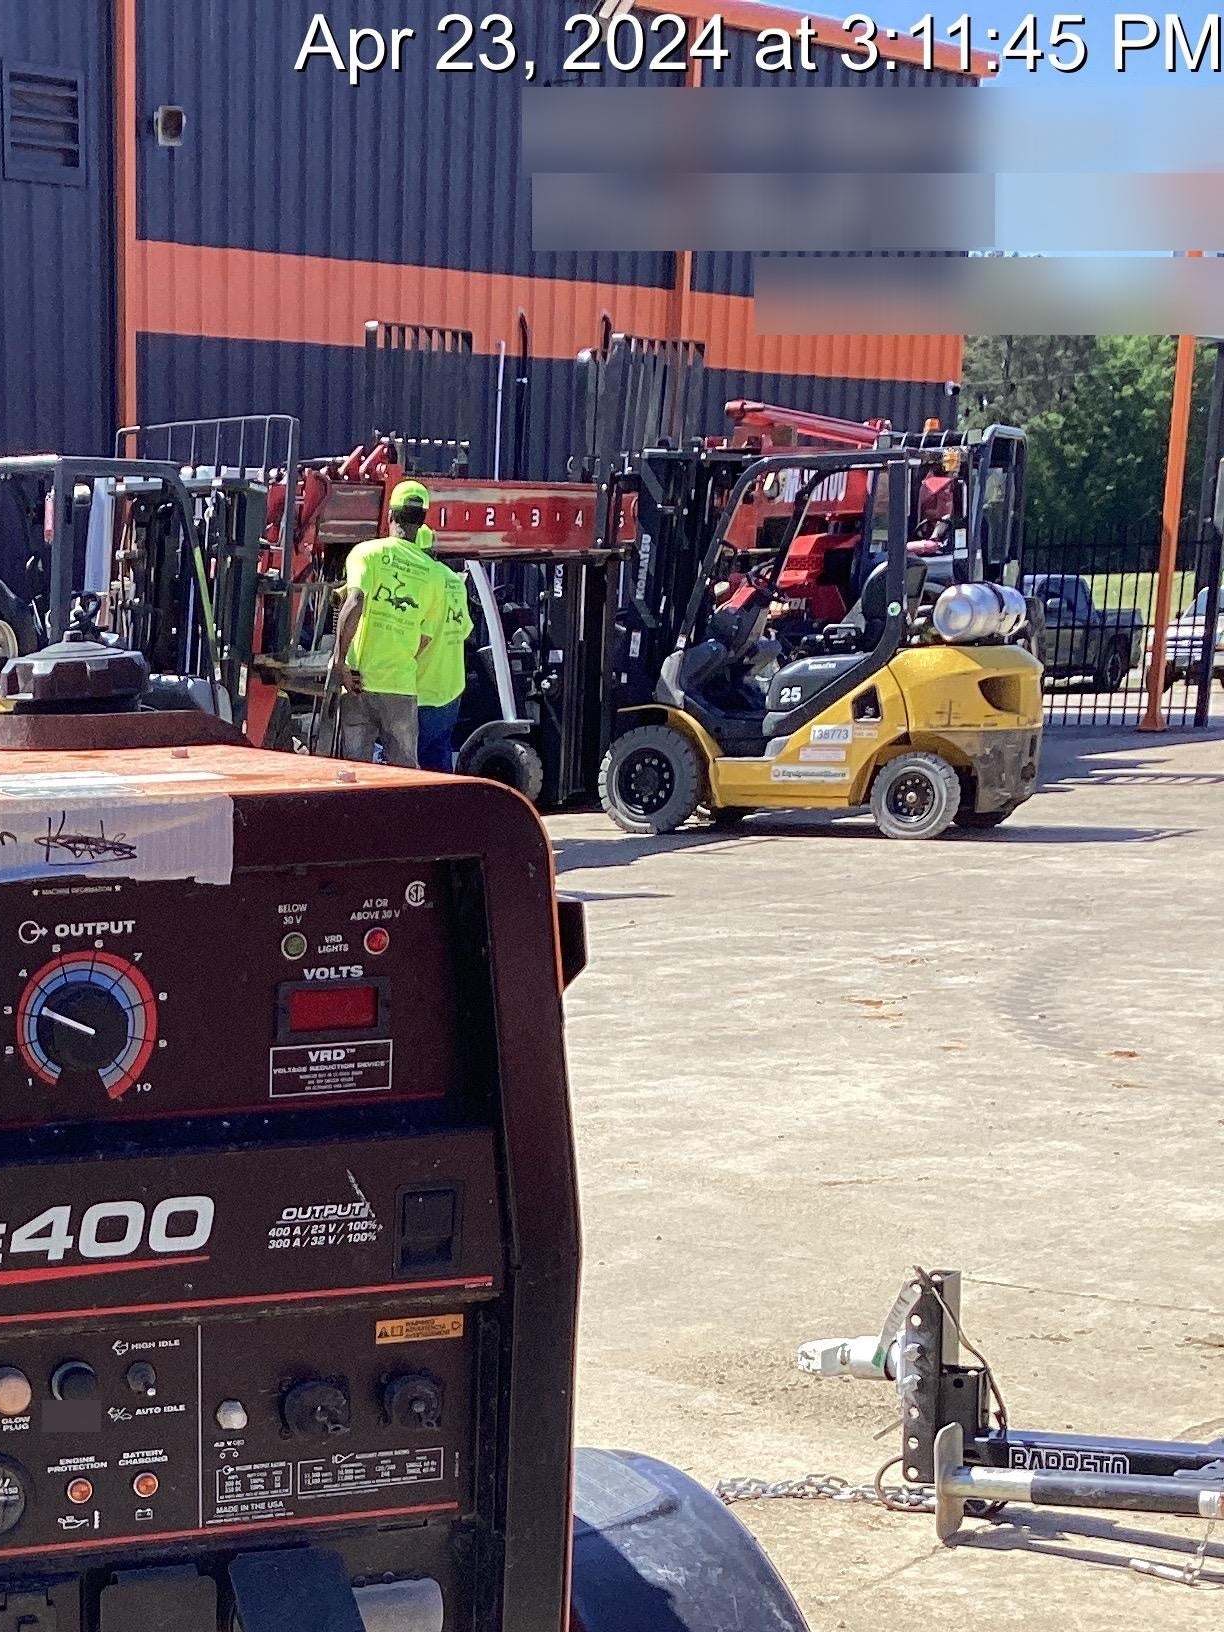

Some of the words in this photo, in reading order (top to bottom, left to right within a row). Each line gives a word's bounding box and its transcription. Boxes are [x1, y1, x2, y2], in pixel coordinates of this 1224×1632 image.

[485, 507, 495, 527] 2
[531, 508, 540, 527] 3
[575, 510, 584, 527] 4
[635, 534, 651, 600] KOMATSU
[779, 687, 802, 704] 25
[278, 903, 308, 914] BELOW
[283, 916, 294, 925] 30
[296, 915, 302, 924] V
[350, 910, 381, 921] ABOVE
[381, 909, 393, 919] 30
[394, 909, 401, 918] V
[54, 919, 136, 938] OUTPUT
[95, 939, 104, 948] 6
[325, 934, 343, 944] VRD
[317, 943, 350, 954] LIGHTS
[134, 952, 143, 962] 7
[18, 968, 28, 978] 4
[303, 965, 364, 981] VOLTS
[3, 1005, 13, 1015] 3
[5, 1045, 15, 1055] 2
[136, 1082, 152, 1092] 10
[281, 1202, 365, 1221] OUTPUT
[268, 1226, 291, 1238] 400
[347, 1220, 377, 1232] 100%
[268, 1238, 291, 1250] 300
[347, 1231, 377, 1243] 100%
[131, 1341, 156, 1350] HIGH
[159, 1339, 180, 1348] IDLE
[135, 1406, 162, 1416] AUTO
[164, 1404, 186, 1414] IDLE
[1, 1416, 31, 1426] GLOW
[2, 1423, 30, 1432] PLUG
[122, 1449, 164, 1460] BATTERY
[59, 1456, 96, 1465] ENGINE
[118, 1455, 169, 1467] CHARGING
[47, 1461, 108, 1474] PROTECTION
[216, 1504, 238, 1514] MADE
[240, 1503, 249, 1512] IN
[251, 1502, 266, 1511] THE
[267, 1500, 284, 1509] USA
